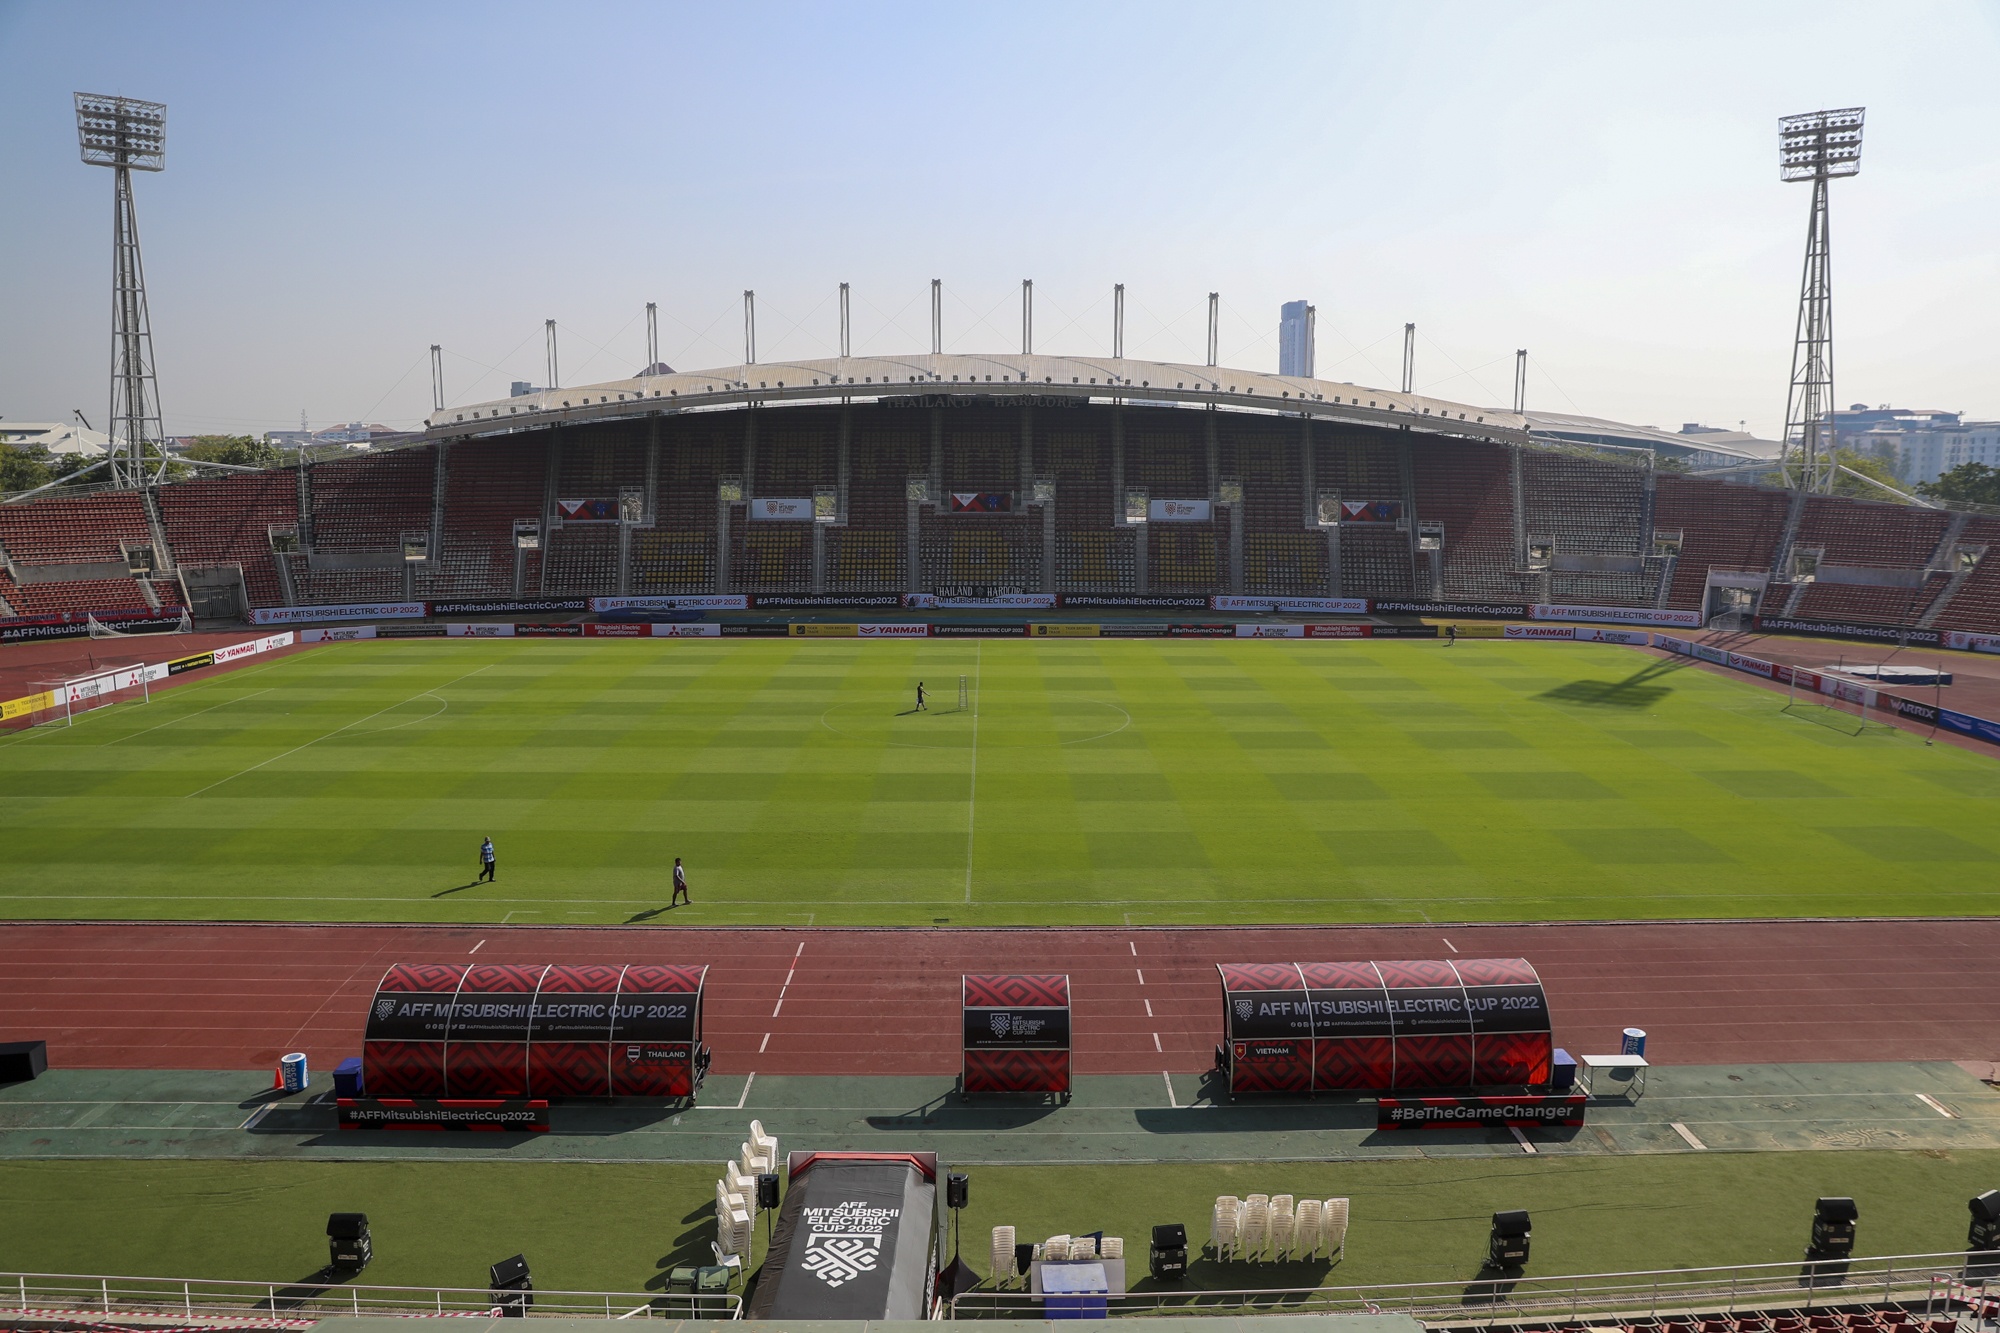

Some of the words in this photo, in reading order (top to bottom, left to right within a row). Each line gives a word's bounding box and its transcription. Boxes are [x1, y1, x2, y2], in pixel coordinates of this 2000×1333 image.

[886, 396, 972, 409] THAILAND
[994, 395, 1080, 409] HARDCORE
[935, 586, 973, 597] THAILAND
[987, 585, 1025, 597] HARDCORE
[273, 611, 290, 619] AFF
[291, 609, 339, 618] MITSUBISHI
[340, 607, 379, 616] ELECTRIC
[380, 606, 399, 615] CUP
[400, 605, 419, 614] 2022
[1376, 602, 1523, 614] #AFFMitsubishiElectricCup2022
[1550, 608, 1567, 616] AFF
[1568, 609, 1613, 618] MITSUBISHI
[1613, 611, 1653, 620] ELECTRIC
[1654, 613, 1672, 621] CUP
[1674, 614, 1694, 623] 2022
[1525, 628, 1571, 636] YANMAR
[1969, 637, 1989, 645] AFF
[226, 644, 255, 658] YANMAR
[1741, 658, 1770, 673] YANMAR
[1890, 698, 1935, 719] WARRIX
[397, 1003, 434, 1017] AFF
[434, 1003, 526, 1018] MTSUBISHI
[526, 1004, 605, 1018] ELECTRIC
[608, 1004, 645, 1018] CUP
[647, 1005, 687, 1018] 2022
[1259, 1002, 1291, 1016] AFF
[1293, 1000, 1384, 1015] MTSUBISHI
[1384, 997, 1461, 1013] ELECTRIC
[1463, 997, 1498, 1011] CUP
[1500, 996, 1540, 1010] 2022
[647, 1050, 686, 1058] THAILAND
[1255, 1047, 1289, 1055] VIETNAM
[285, 1063, 293, 1088] SWEAT
[290, 1062, 298, 1091] POCARI
[349, 1110, 536, 1123] #AFFMitsubishiElectricCup2022
[1391, 1104, 1573, 1120] #BeTheGameChanger
[838, 1201, 868, 1209] AFF
[803, 1208, 900, 1218] MITSUBISHI
[807, 1216, 891, 1225] ELECTRIC
[812, 1224, 845, 1233] CUP
[847, 1225, 883, 1233] 2022
